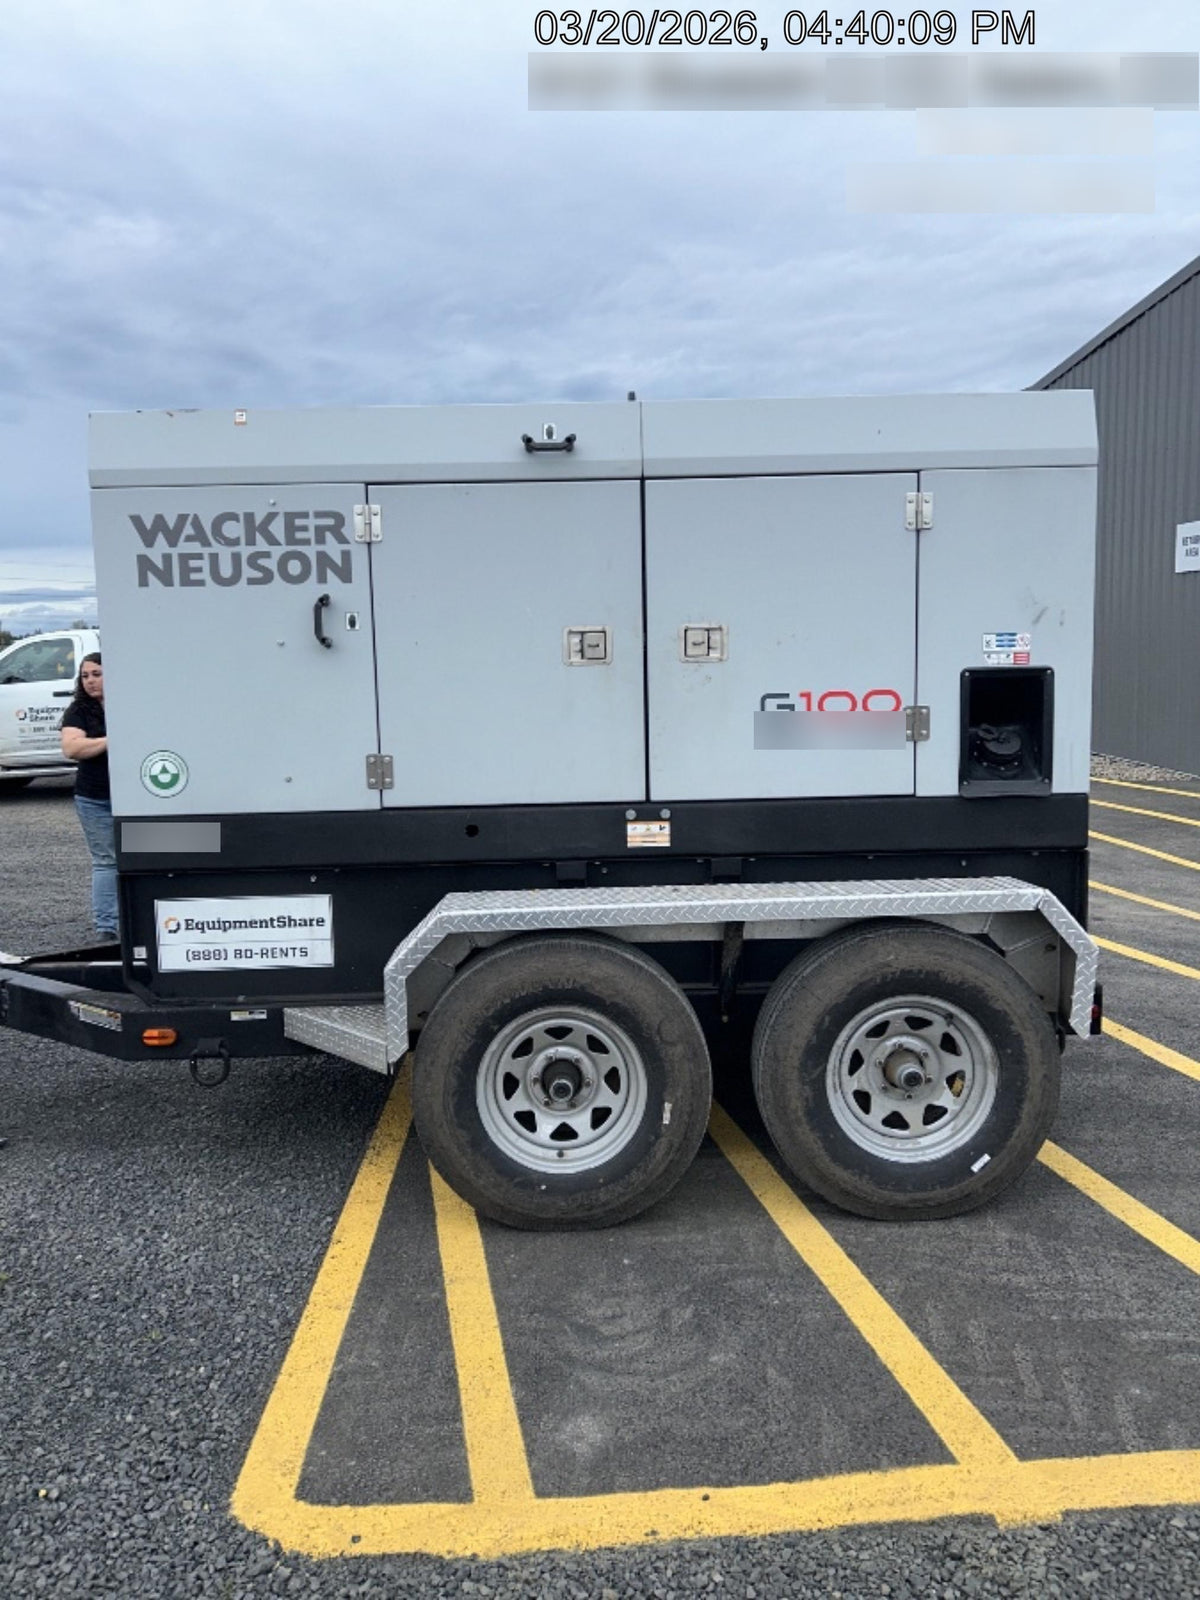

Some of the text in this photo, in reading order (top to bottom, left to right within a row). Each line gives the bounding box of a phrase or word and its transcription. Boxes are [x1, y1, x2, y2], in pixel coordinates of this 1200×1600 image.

[128, 510, 351, 548] WACKER
[136, 550, 352, 587] NEUSON
[184, 915, 325, 934] EquipmentShare
